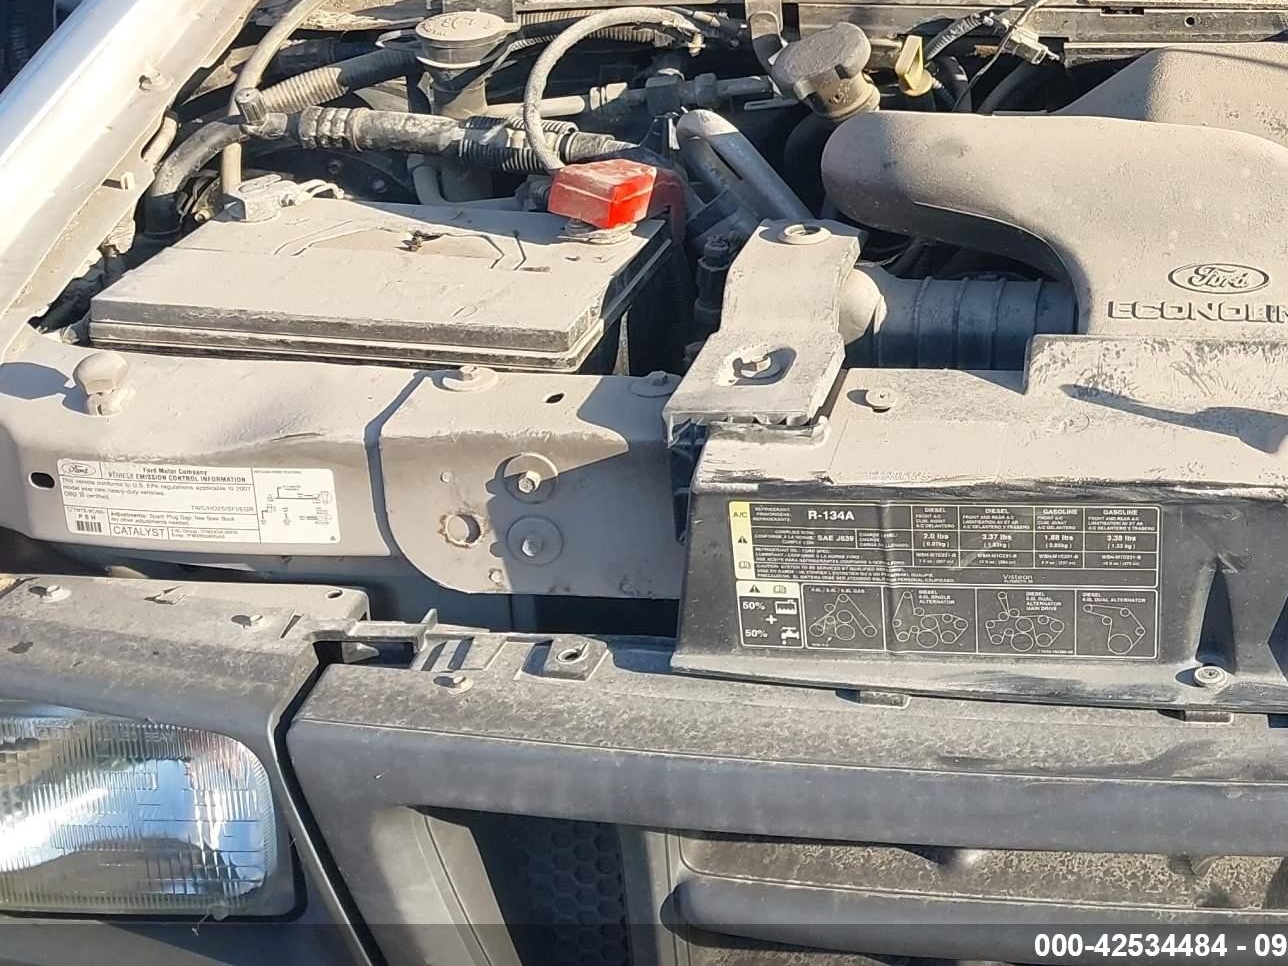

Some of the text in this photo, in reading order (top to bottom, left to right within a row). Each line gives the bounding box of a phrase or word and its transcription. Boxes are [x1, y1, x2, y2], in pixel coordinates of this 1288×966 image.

[1187, 265, 1249, 288] Ford
[808, 510, 855, 520] R-134A
[113, 525, 166, 538] CATALYST
[742, 601, 766, 610] 50%
[744, 629, 768, 637] 50%
